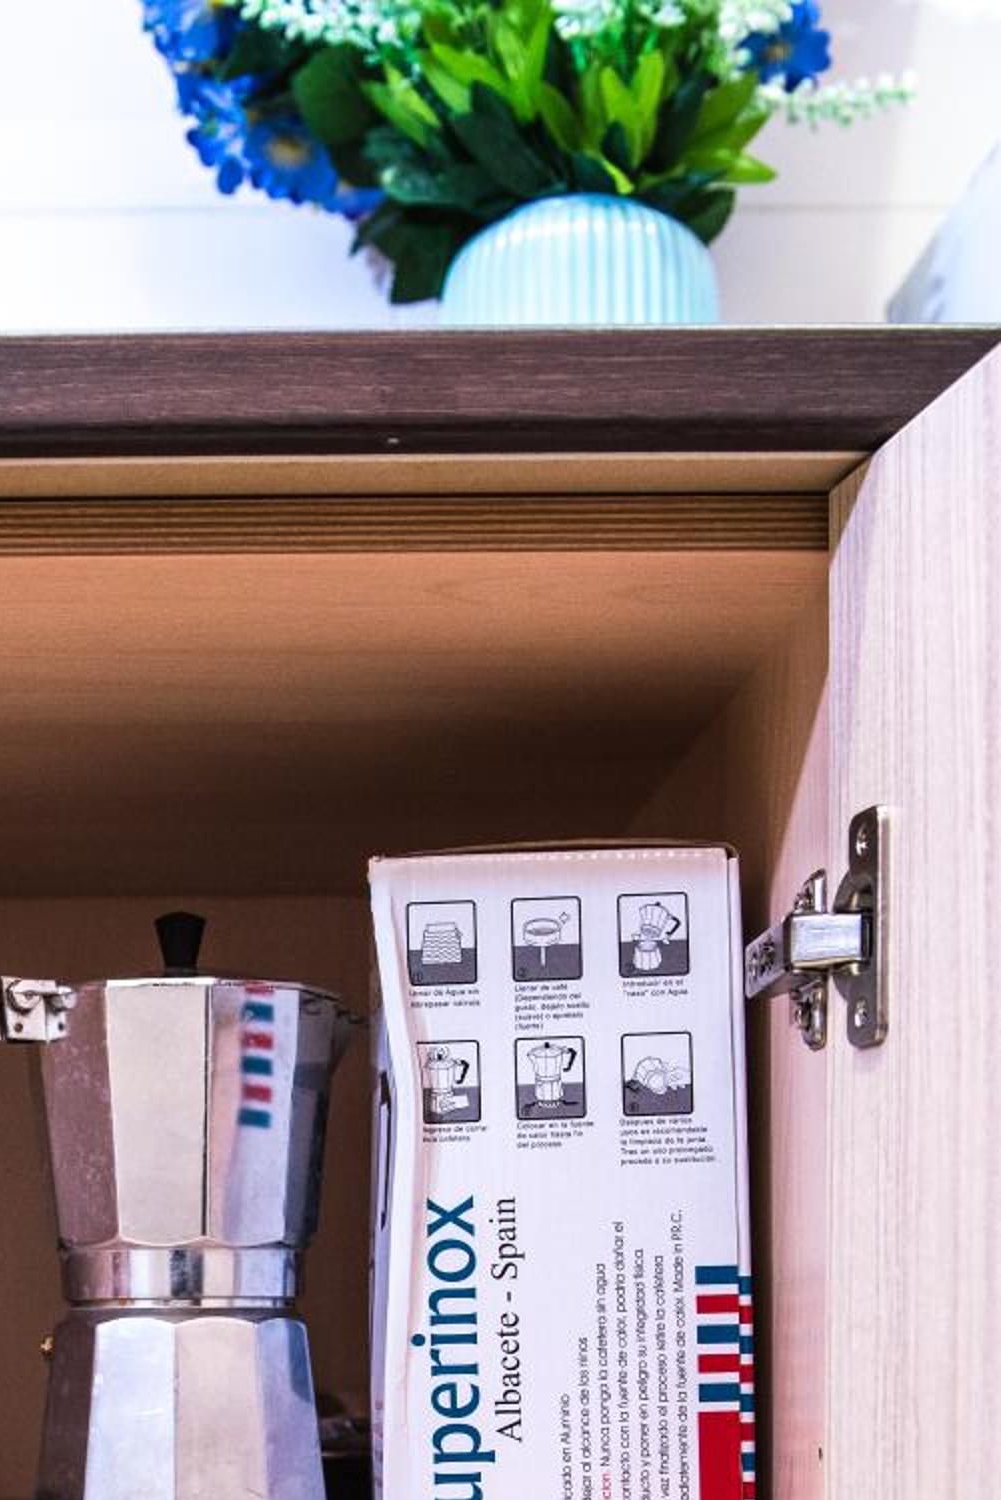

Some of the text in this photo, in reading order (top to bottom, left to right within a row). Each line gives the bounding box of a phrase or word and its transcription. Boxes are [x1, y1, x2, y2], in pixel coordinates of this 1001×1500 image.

[488, 1197, 525, 1280] Spain
[595, 1263, 607, 1296] agua
[672, 1256, 684, 1292] Made
[675, 1331, 686, 1347] de
[617, 1351, 627, 1368] de
[494, 1312, 522, 1443] Albacete
[580, 1389, 590, 1405] de
[638, 1404, 648, 1419] en
[677, 1406, 687, 1422] de
[621, 1426, 630, 1448] con
[563, 1448, 571, 1462] en
